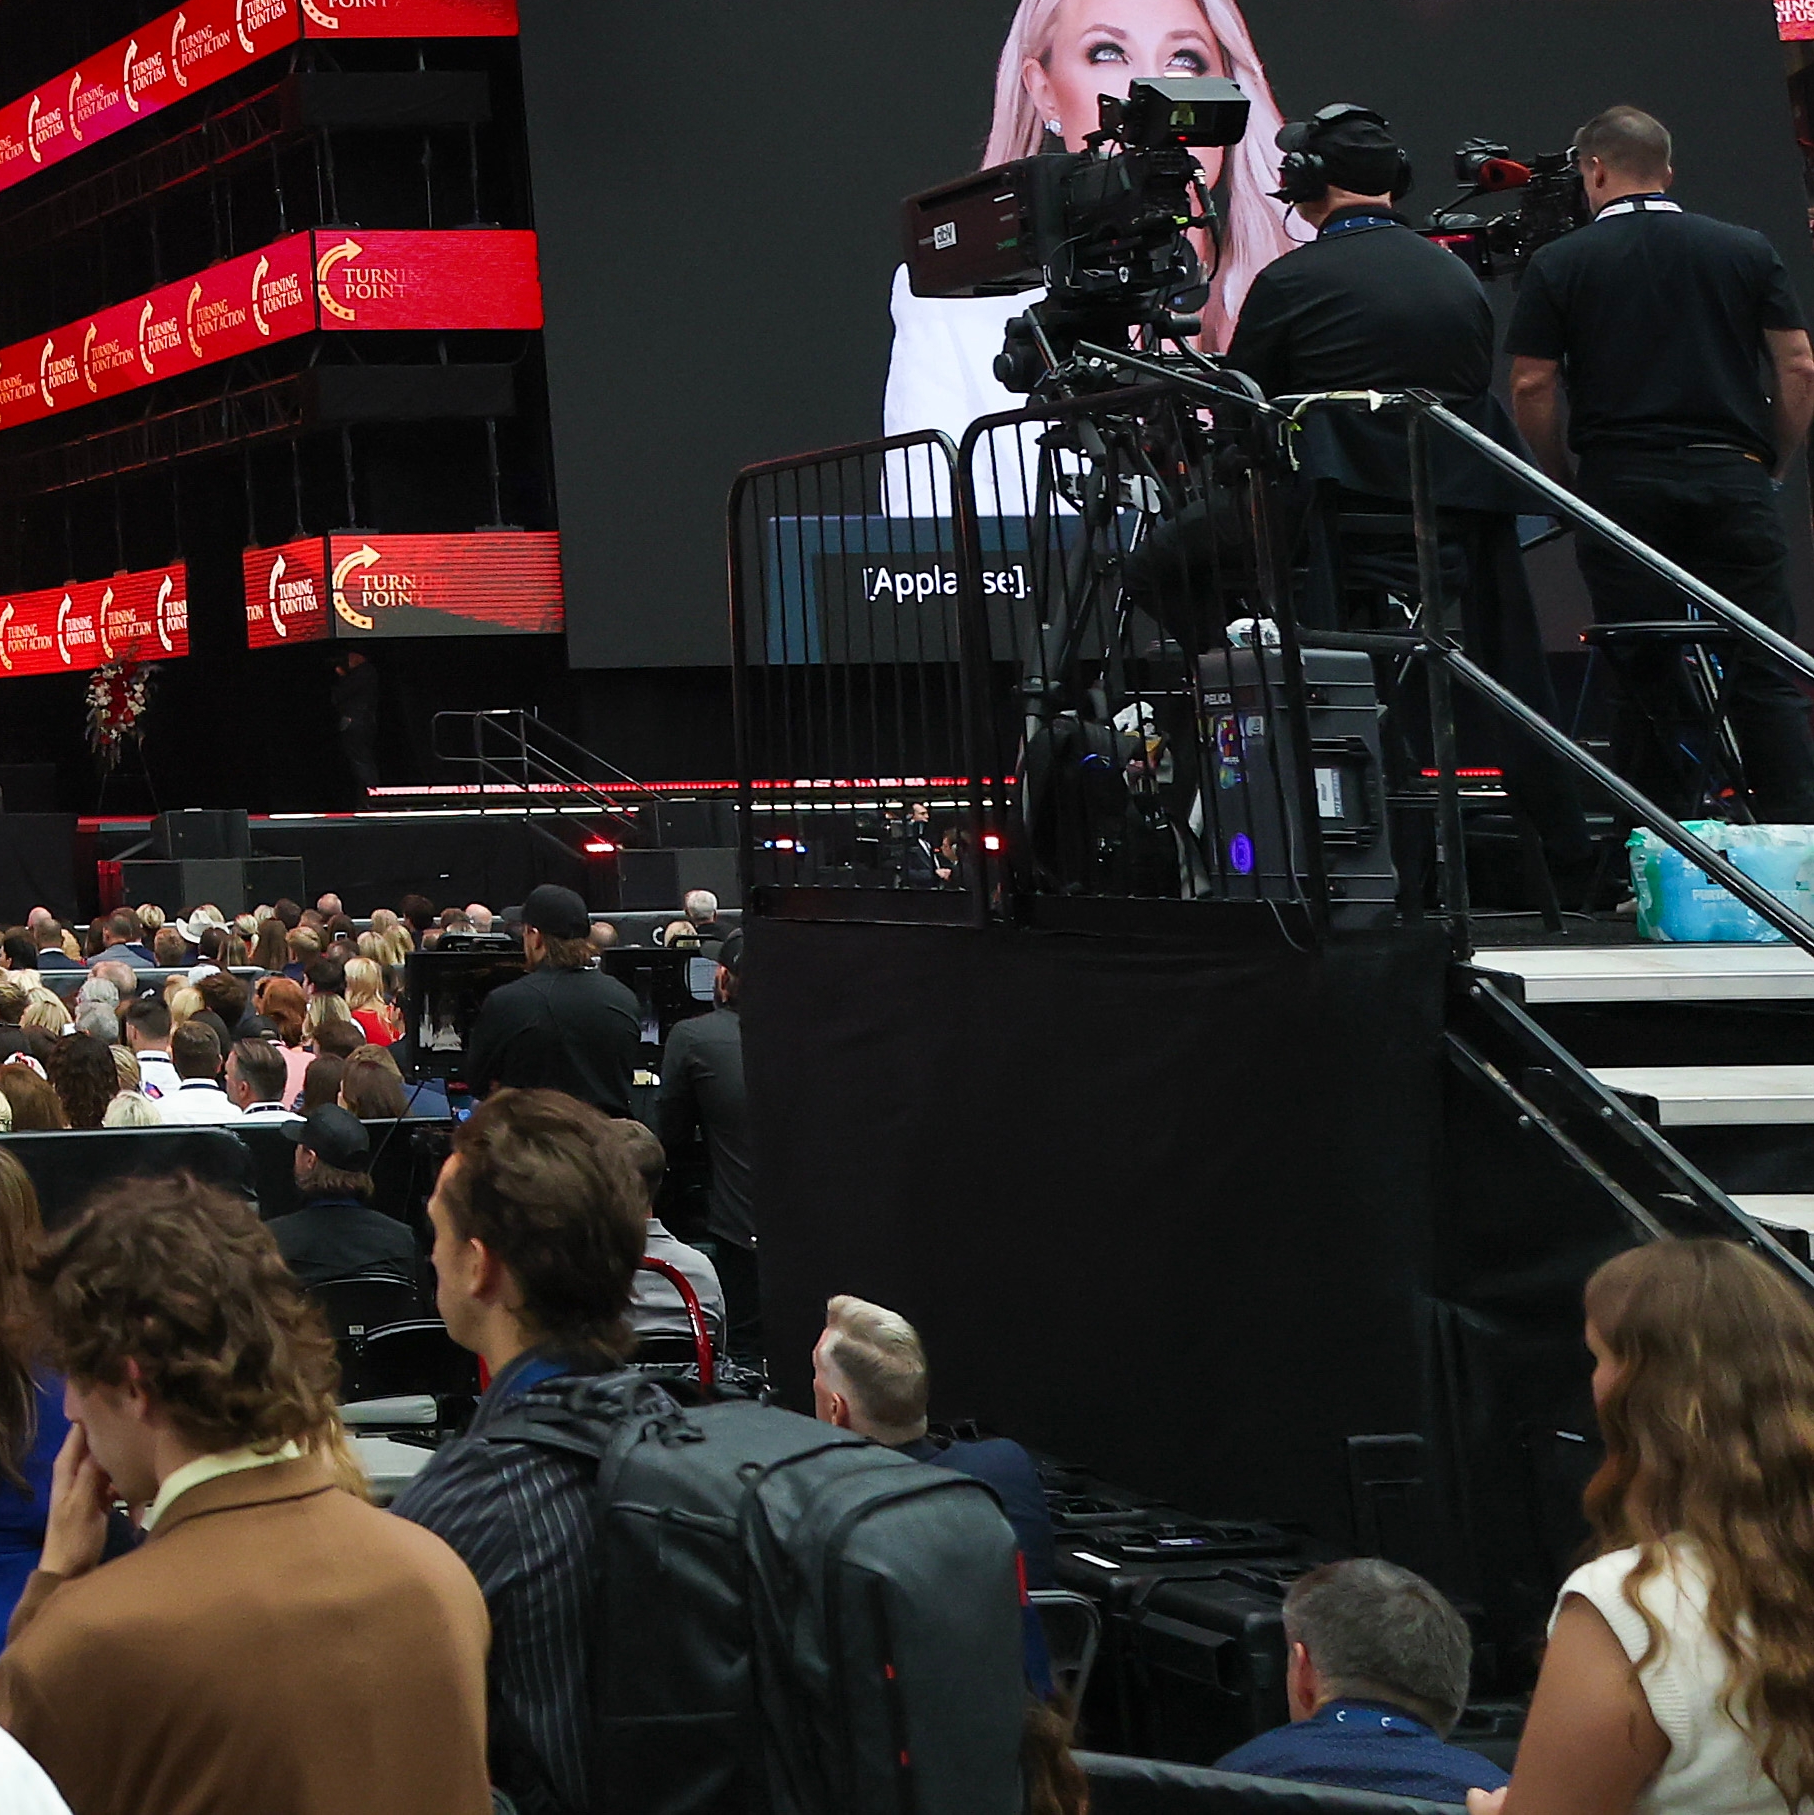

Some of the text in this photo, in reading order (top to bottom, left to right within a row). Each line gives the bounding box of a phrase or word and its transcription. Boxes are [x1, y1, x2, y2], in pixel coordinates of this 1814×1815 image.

[247, 0, 287, 33] POINT USA
[261, 273, 298, 298] TURNING
[263, 289, 303, 315] POINT USA
[278, 578, 314, 600] TURNING
[862, 564, 1031, 603] [Applase].
[280, 594, 319, 616] POINT USA
